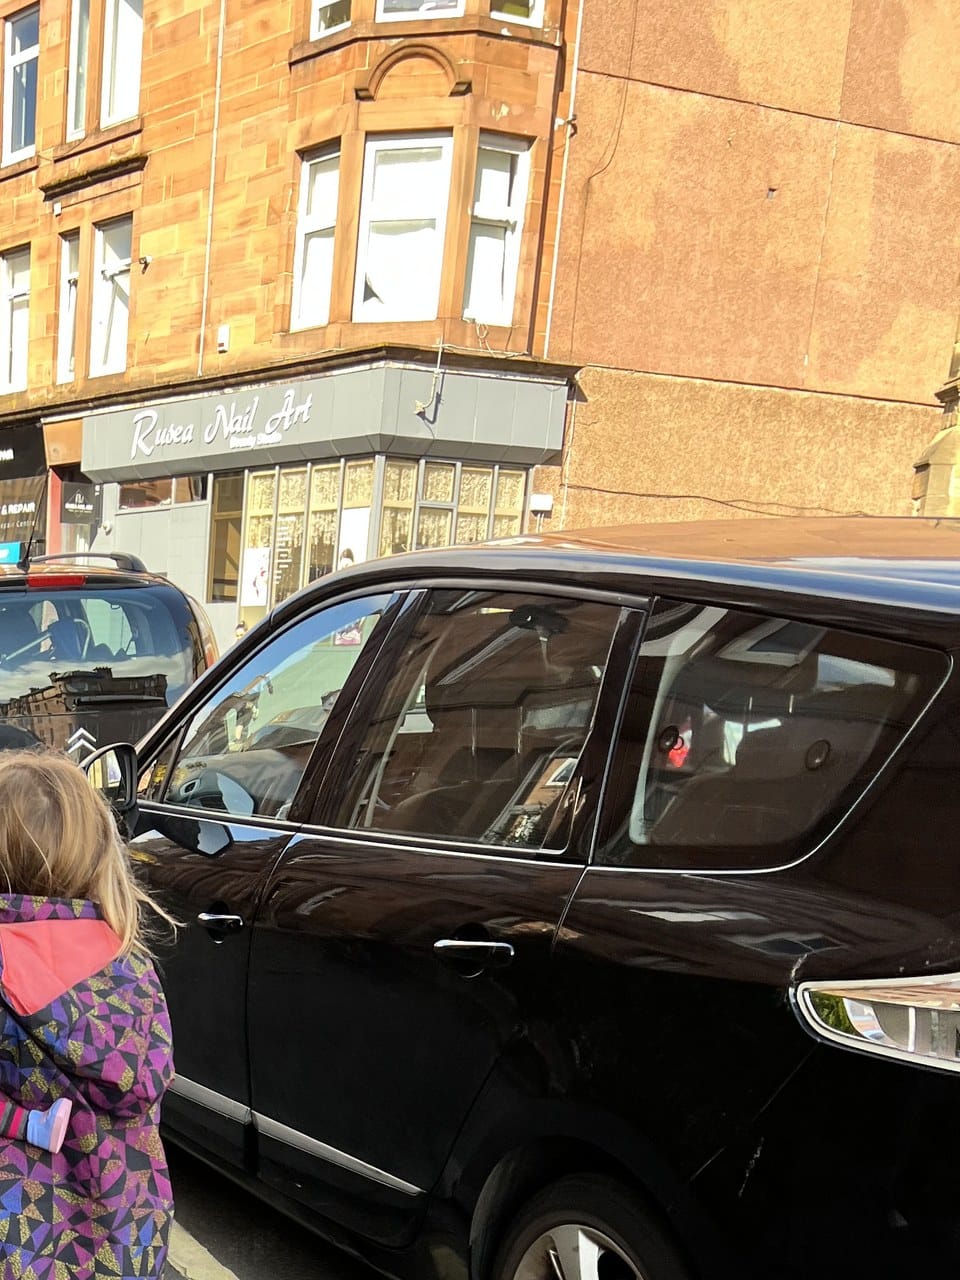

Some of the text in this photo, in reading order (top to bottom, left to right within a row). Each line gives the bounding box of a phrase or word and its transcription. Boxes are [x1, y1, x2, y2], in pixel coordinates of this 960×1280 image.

[130, 388, 313, 460] Rusea Nail Art
[1, 504, 7, 516] &
[8, 502, 35, 514] REPAIR
